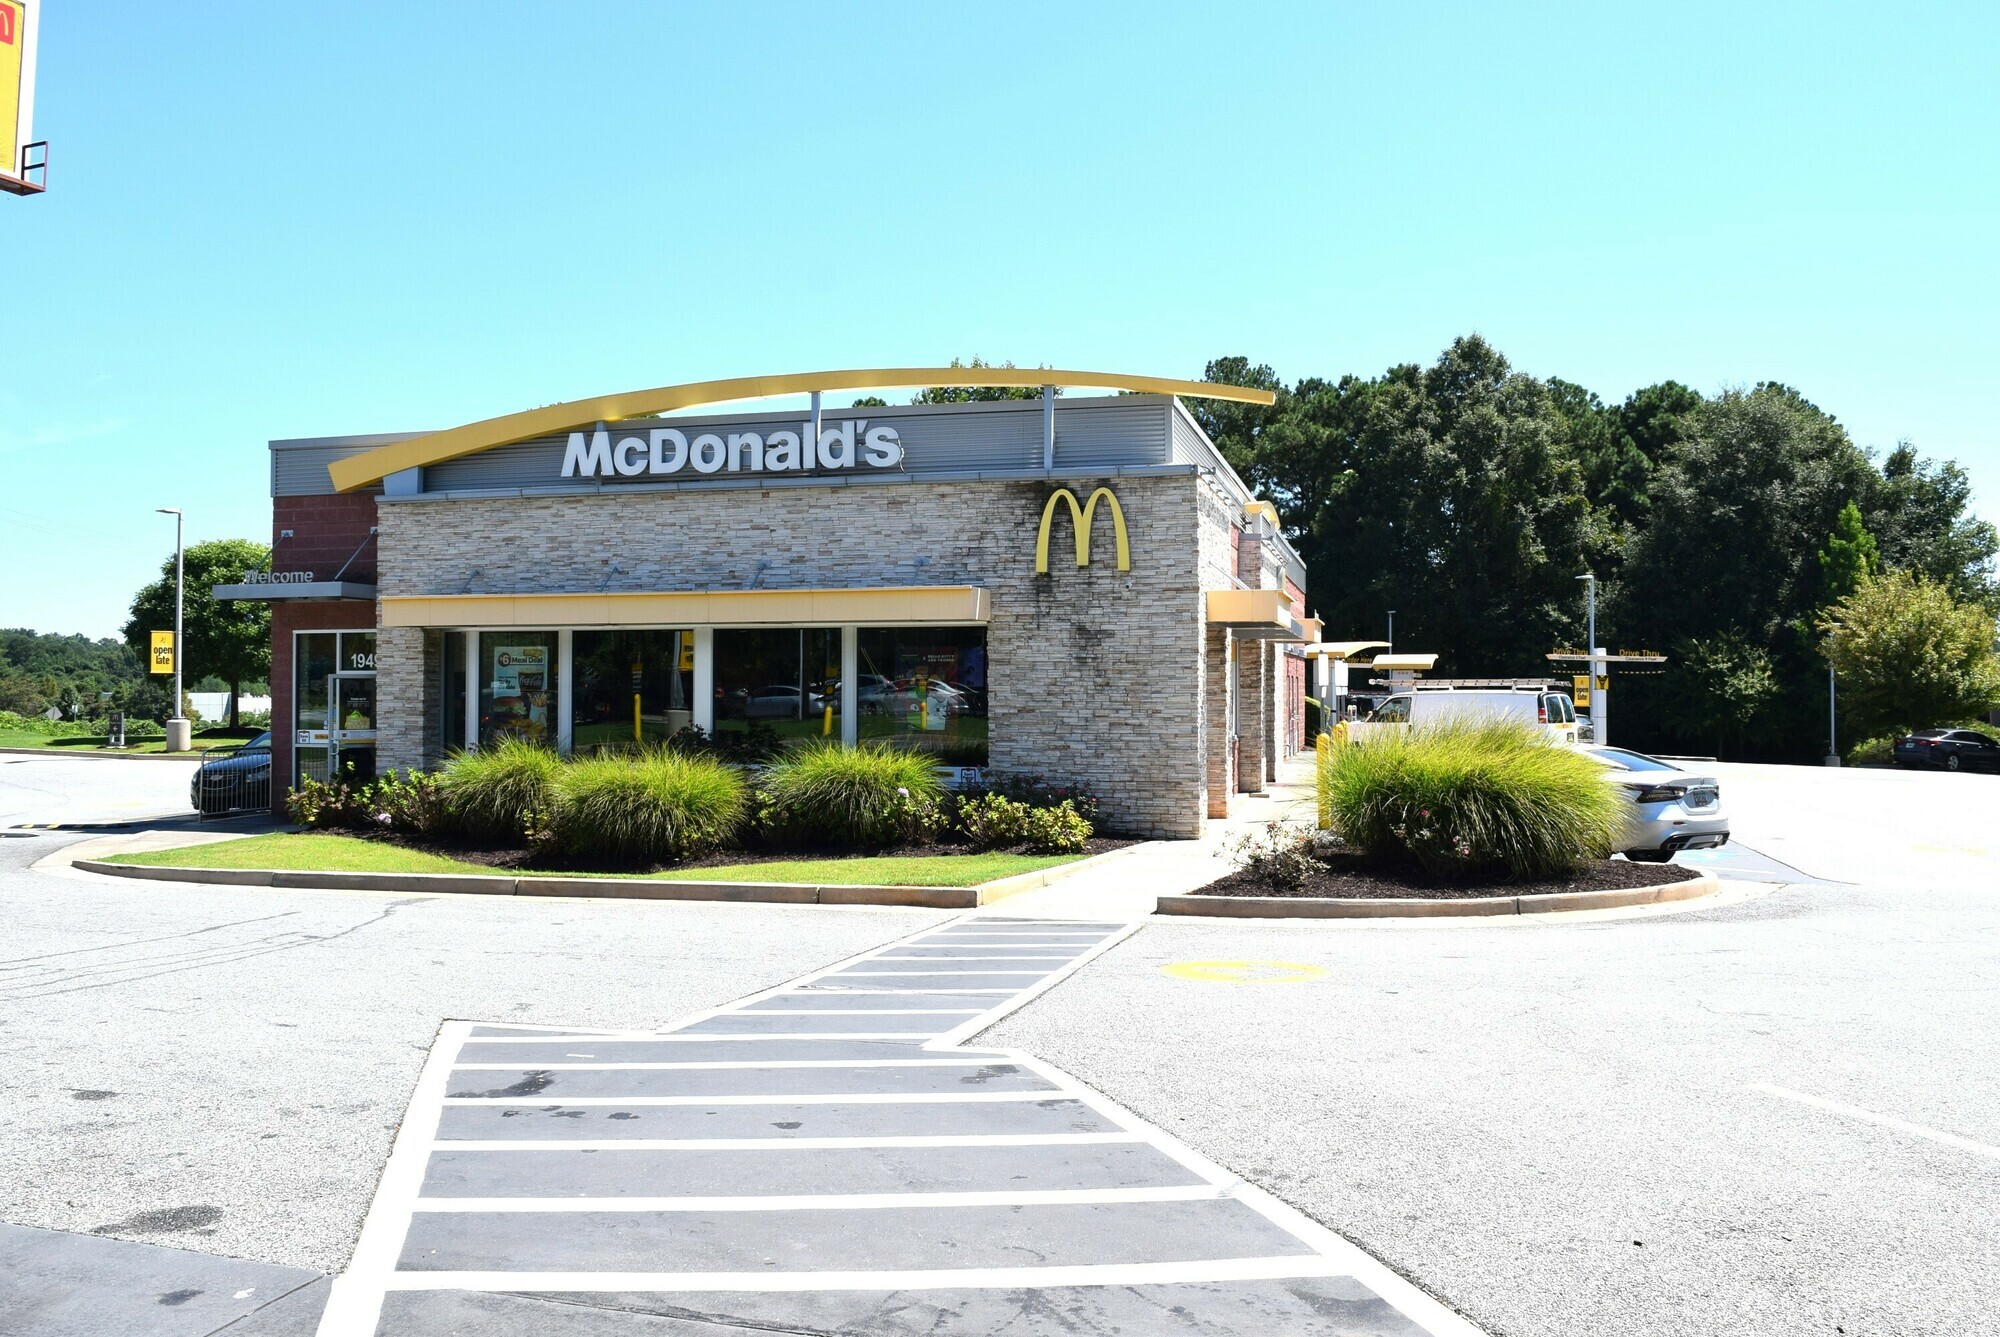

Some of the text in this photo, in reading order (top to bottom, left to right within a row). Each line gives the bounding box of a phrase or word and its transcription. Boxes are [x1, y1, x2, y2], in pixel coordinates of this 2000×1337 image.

[560, 420, 901, 477] McDonald's
[244, 569, 314, 584] Welcome
[153, 646, 173, 656] open
[1552, 647, 1571, 655] Drive
[155, 655, 170, 664] late
